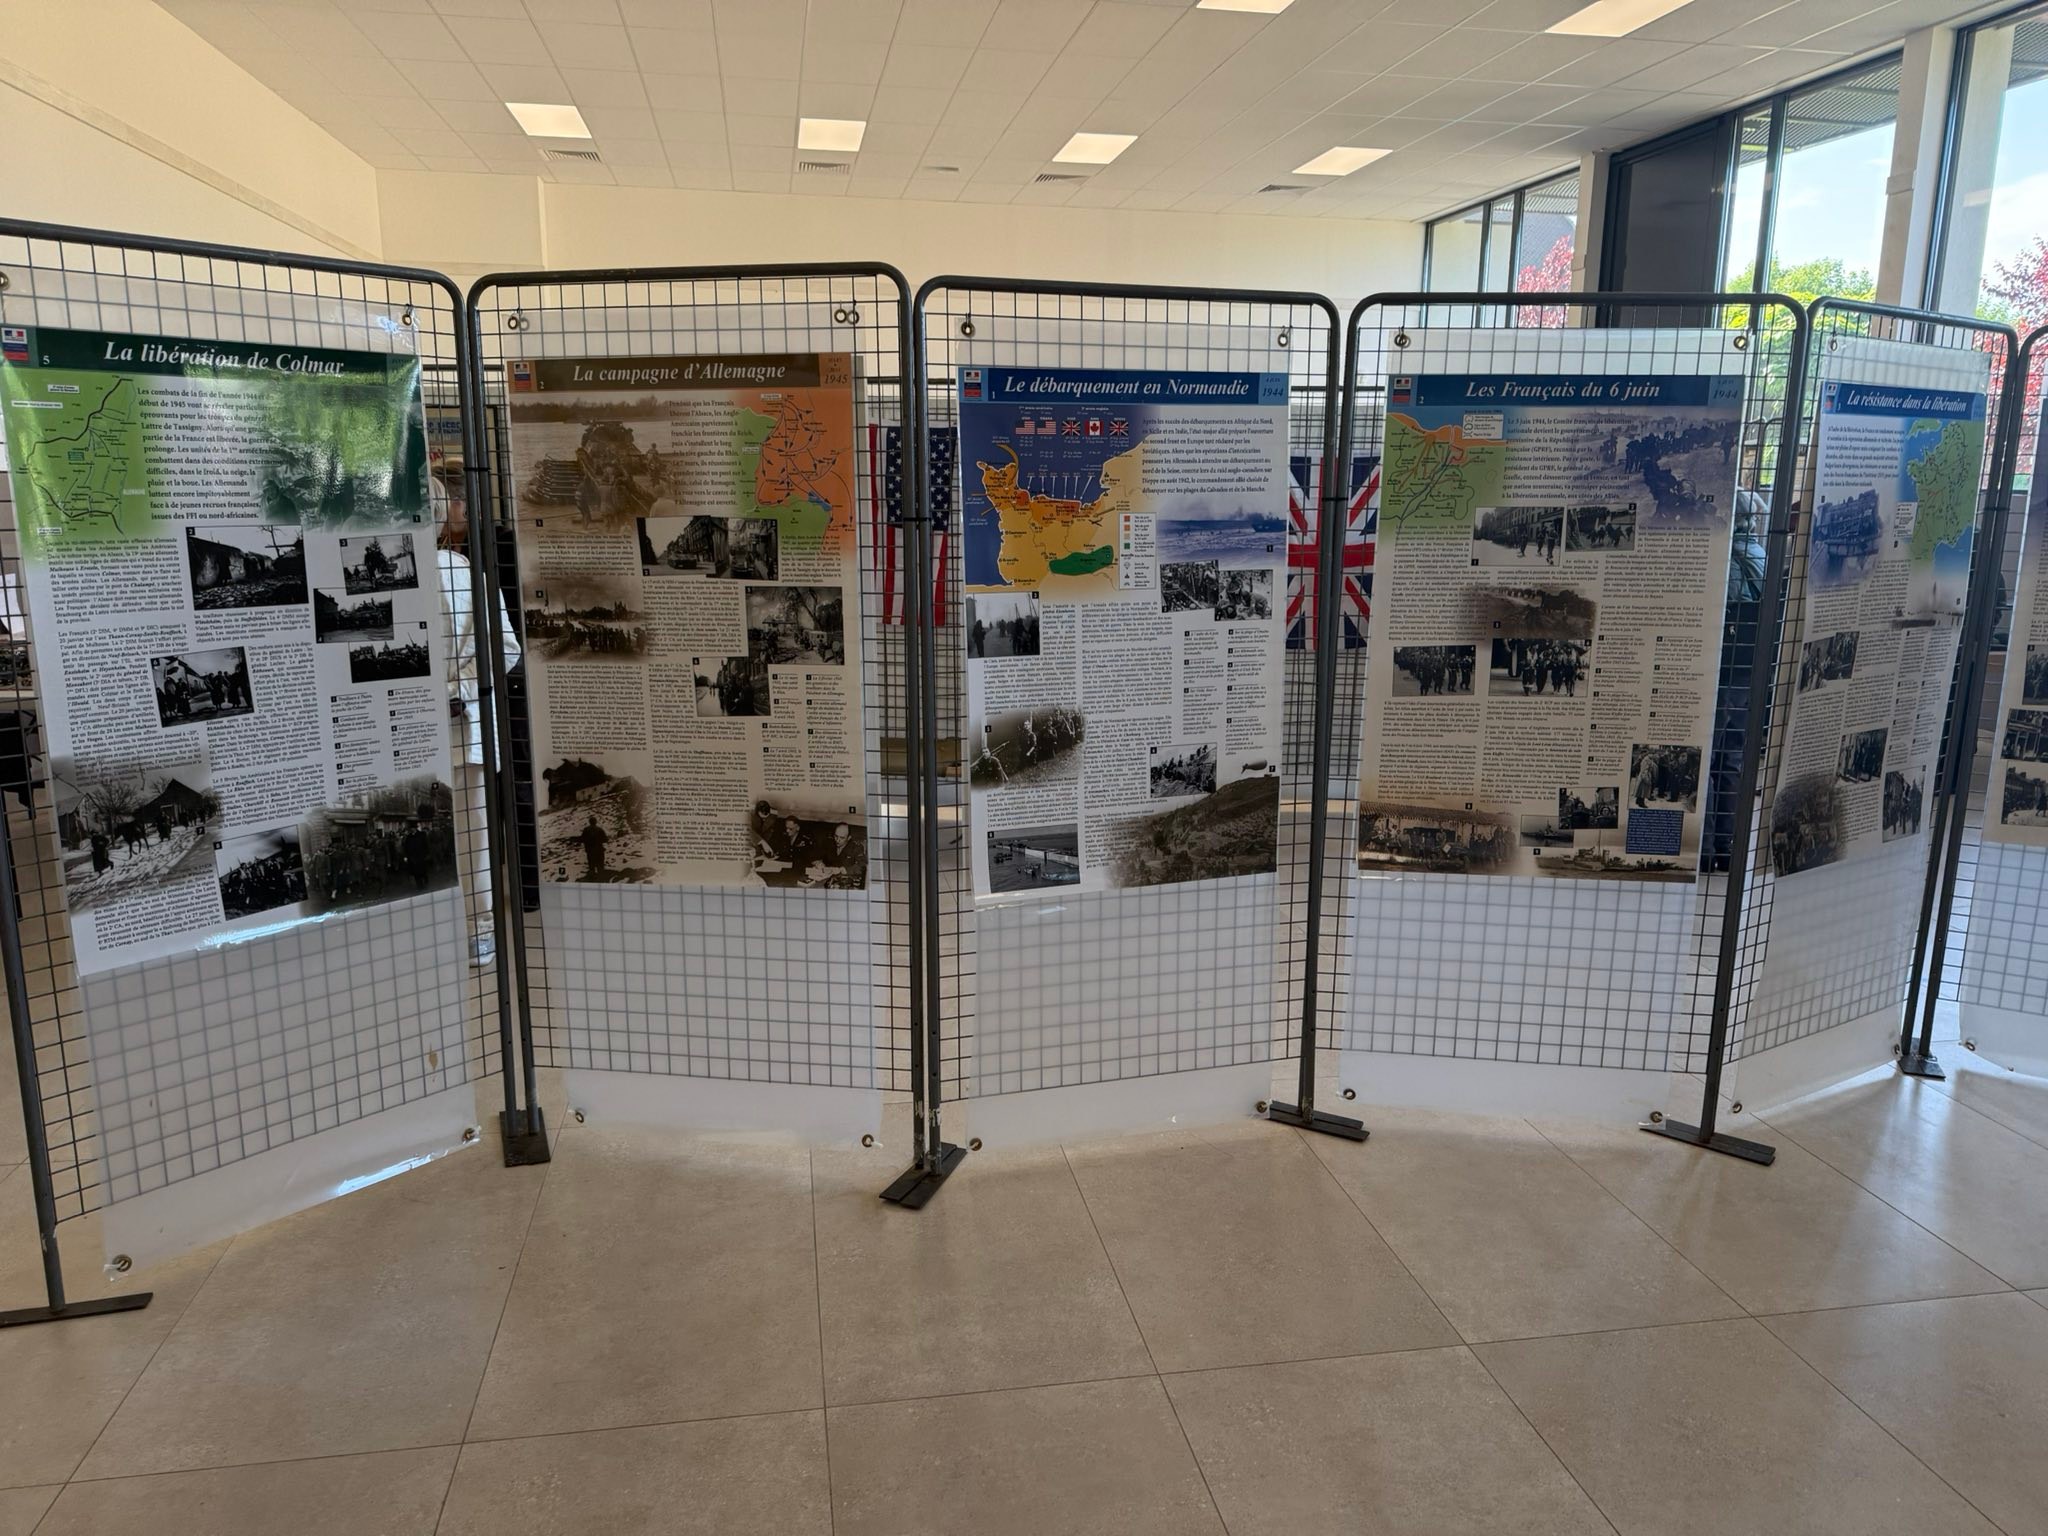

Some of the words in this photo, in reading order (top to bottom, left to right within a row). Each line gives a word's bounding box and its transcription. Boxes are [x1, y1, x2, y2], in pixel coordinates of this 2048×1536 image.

[43, 356, 49, 364] 5
[104, 342, 133, 360] La
[141, 344, 240, 366] libération
[247, 351, 269, 368] de
[276, 354, 344, 373] Colmar
[574, 365, 592, 381] La
[599, 366, 678, 385] campagne
[684, 363, 786, 383] d'Allemagne
[824, 374, 848, 385] 1945
[1004, 376, 1023, 392] Le
[1029, 377, 1139, 397] débarquement
[1143, 382, 1160, 394] en
[1165, 379, 1248, 395] Normandie
[1466, 382, 1495, 397] Les
[1501, 382, 1576, 400] Français
[1580, 382, 1602, 397] du
[1609, 382, 1619, 397] 6
[1621, 382, 1660, 401] juin
[151, 388, 180, 396] combats
[1263, 387, 1284, 397] 1944
[1713, 390, 1738, 399] 1944
[712, 399, 734, 408] Français
[1847, 390, 1858, 405] La
[1861, 392, 1902, 408] résistance
[1902, 395, 1920, 409] dans
[1922, 396, 1930, 410] la
[1931, 396, 1967, 412] libération
[139, 410, 178, 420] éprouvants
[173, 423, 204, 433] Tassigny.
[142, 434, 163, 443] partie
[216, 435, 240, 444] libérée,
[144, 445, 176, 454] prolonge.
[146, 467, 178, 476] difficiles,
[203, 468, 221, 476] froid,
[147, 478, 164, 488] pluie
[196, 490, 250, 499] impitoyablement
[180, 501, 201, 510] jeunes
[228, 500, 260, 510] françaises,
